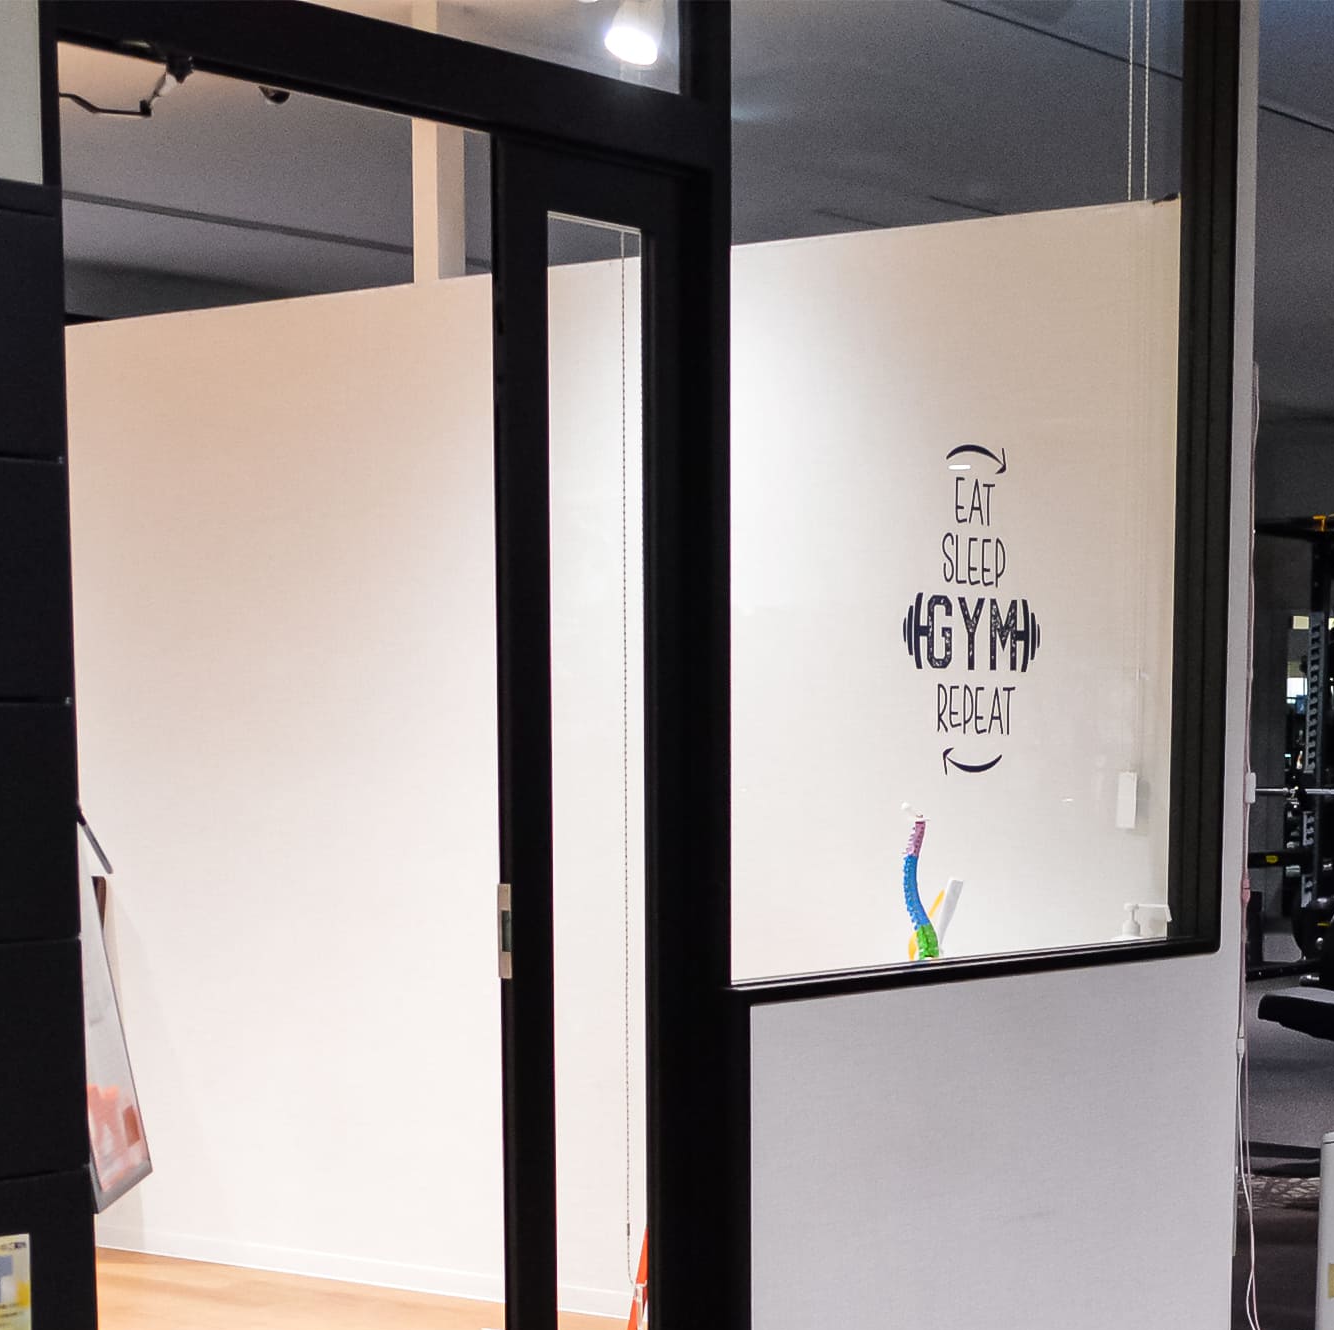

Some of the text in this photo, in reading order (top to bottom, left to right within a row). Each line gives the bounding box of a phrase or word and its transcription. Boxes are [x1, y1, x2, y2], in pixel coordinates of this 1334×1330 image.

[955, 476, 996, 527] EAT
[941, 532, 1007, 588] SLEEP
[926, 594, 1018, 671] GYM
[936, 683, 1016, 736] REPEAT
